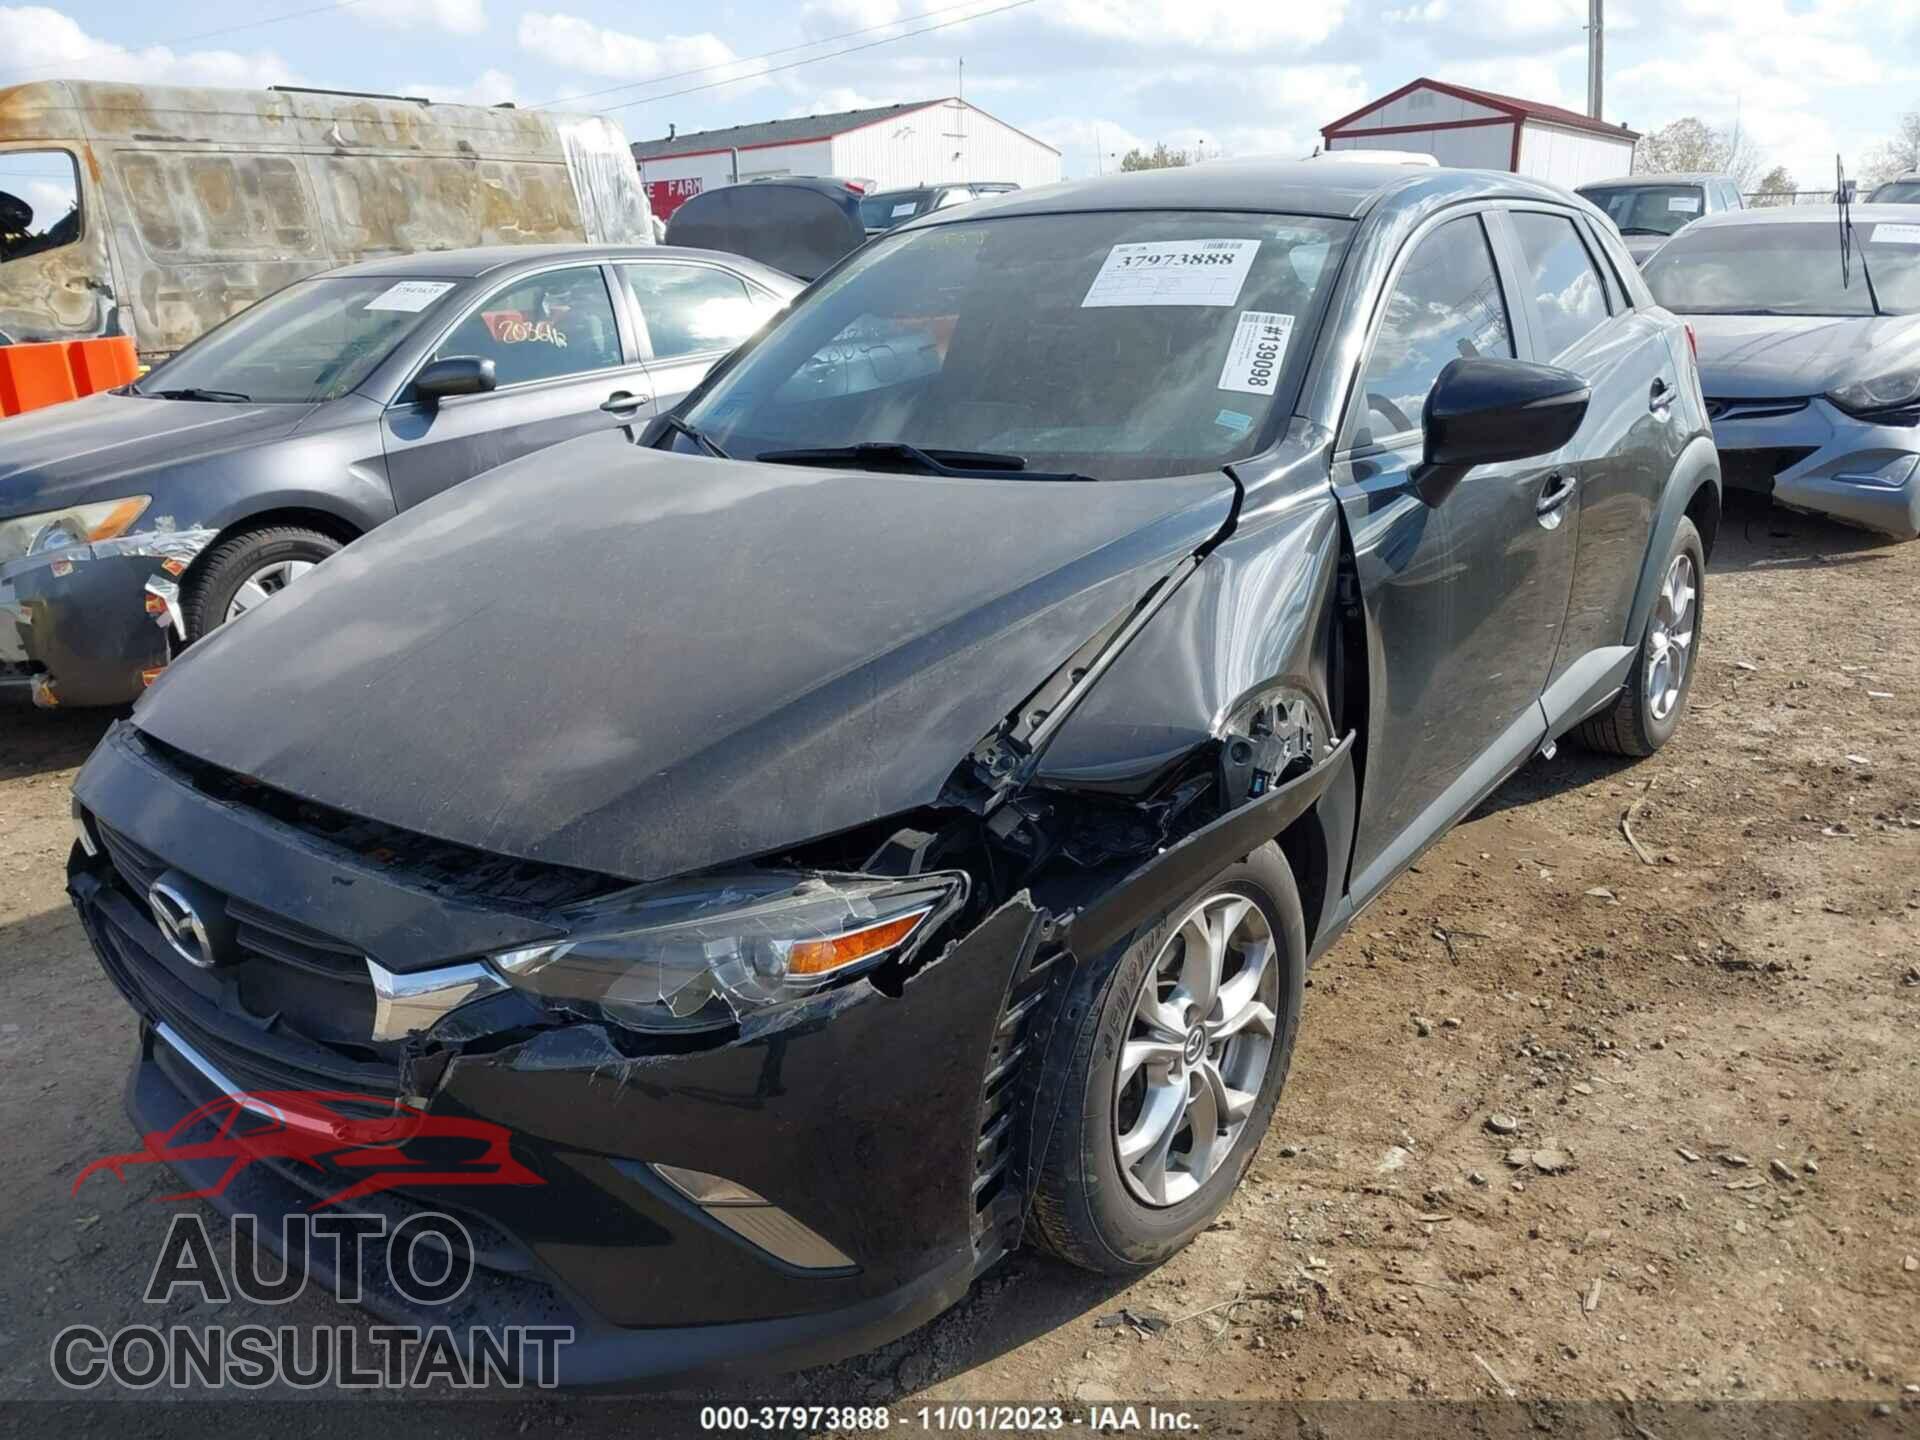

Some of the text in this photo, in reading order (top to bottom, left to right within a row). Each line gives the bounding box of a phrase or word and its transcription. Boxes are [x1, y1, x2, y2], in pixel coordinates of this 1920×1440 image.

[668, 177, 704, 197] FARM
[1117, 252, 1235, 268] 37973888
[1247, 325, 1284, 387] #139098
